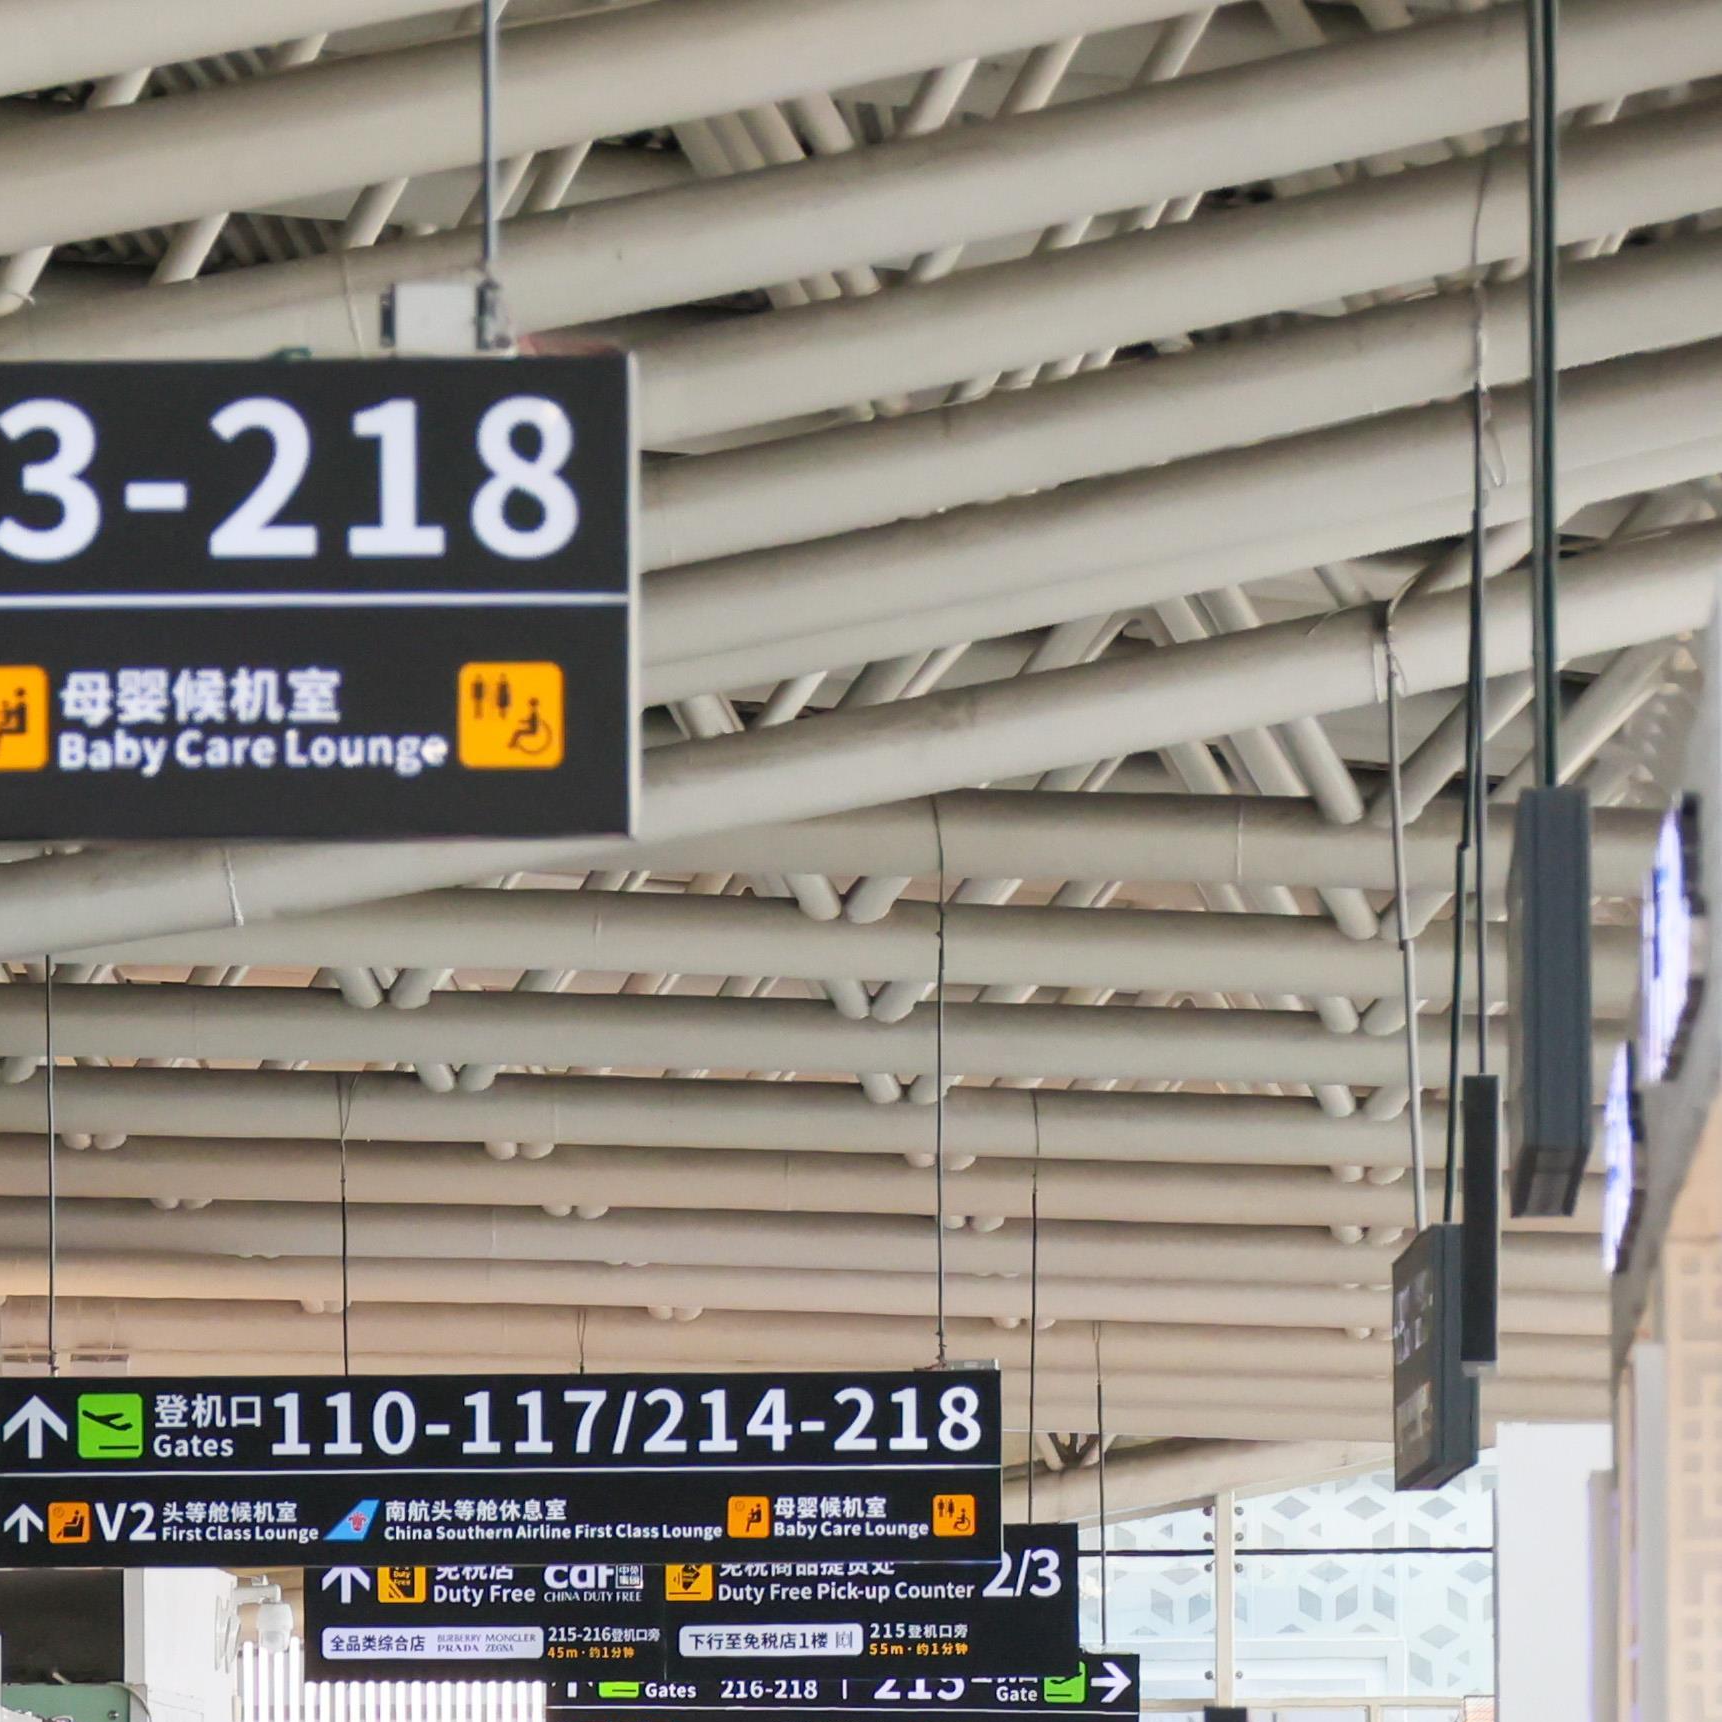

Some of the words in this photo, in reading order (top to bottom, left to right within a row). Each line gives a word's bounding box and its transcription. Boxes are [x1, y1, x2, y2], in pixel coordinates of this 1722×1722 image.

[60, 667, 341, 725] 母婴候机室
[58, 728, 168, 777] Baby
[175, 729, 277, 768] Care
[285, 728, 449, 775] Lounge
[154, 1392, 262, 1429] 登机口
[271, 1386, 982, 1456] 110-117/214-218
[153, 1433, 234, 1458] Gates
[162, 1500, 298, 1524] 头等舱候机室
[385, 1498, 567, 1523] 南航头等舱休息室
[773, 1495, 887, 1520] 母婴候机室
[94, 1501, 157, 1542] V2
[384, 1525, 433, 1541] China
[435, 1524, 513, 1541] Southern
[515, 1523, 572, 1540] Airline
[574, 1523, 613, 1539] First
[615, 1523, 660, 1539] Class
[662, 1524, 723, 1541] Lounge
[773, 1520, 818, 1540] Baby
[820, 1520, 862, 1537] Care
[864, 1521, 929, 1540] Lounge
[162, 1525, 203, 1542] First
[205, 1525, 252, 1542] Class
[254, 1525, 319, 1544] Lounge
[982, 1548, 1062, 1598] 2/3
[433, 1584, 485, 1608] Duty
[489, 1584, 536, 1603] Free
[543, 1591, 581, 1603] CHINA
[583, 1590, 614, 1602] DUTY
[615, 1591, 642, 1602] FREE
[718, 1583, 765, 1606] Duty
[770, 1583, 813, 1601] Free
[817, 1581, 891, 1604] Pick-up
[894, 1581, 976, 1600] Counter
[485, 1633, 537, 1643] MONCLER
[548, 1626, 661, 1643] 215-216登机口旁
[688, 1631, 828, 1651] 下行至免税店1楼
[869, 1622, 968, 1639] 215登机口旁
[330, 1634, 425, 1652] 全品类综合店
[437, 1644, 479, 1652] PRADA
[642, 1681, 697, 1699] Gates
[720, 1679, 818, 1700] 216-218
[995, 1685, 1038, 1702] Gate
